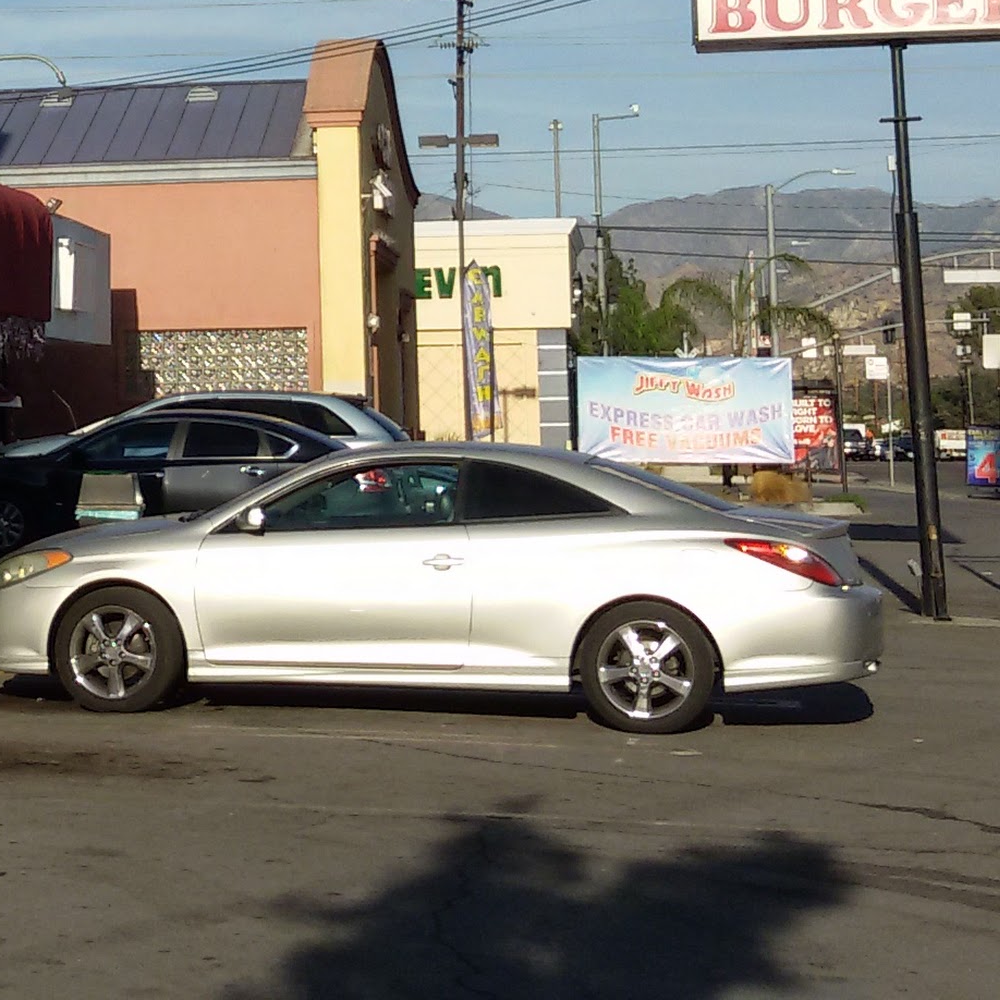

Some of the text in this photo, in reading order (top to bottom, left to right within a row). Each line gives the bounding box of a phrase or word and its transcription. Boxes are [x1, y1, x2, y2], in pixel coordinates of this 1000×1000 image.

[817, 398, 831, 407] TO
[588, 402, 783, 431] EXPRESS CAR WASH
[610, 426, 657, 448] FREE
